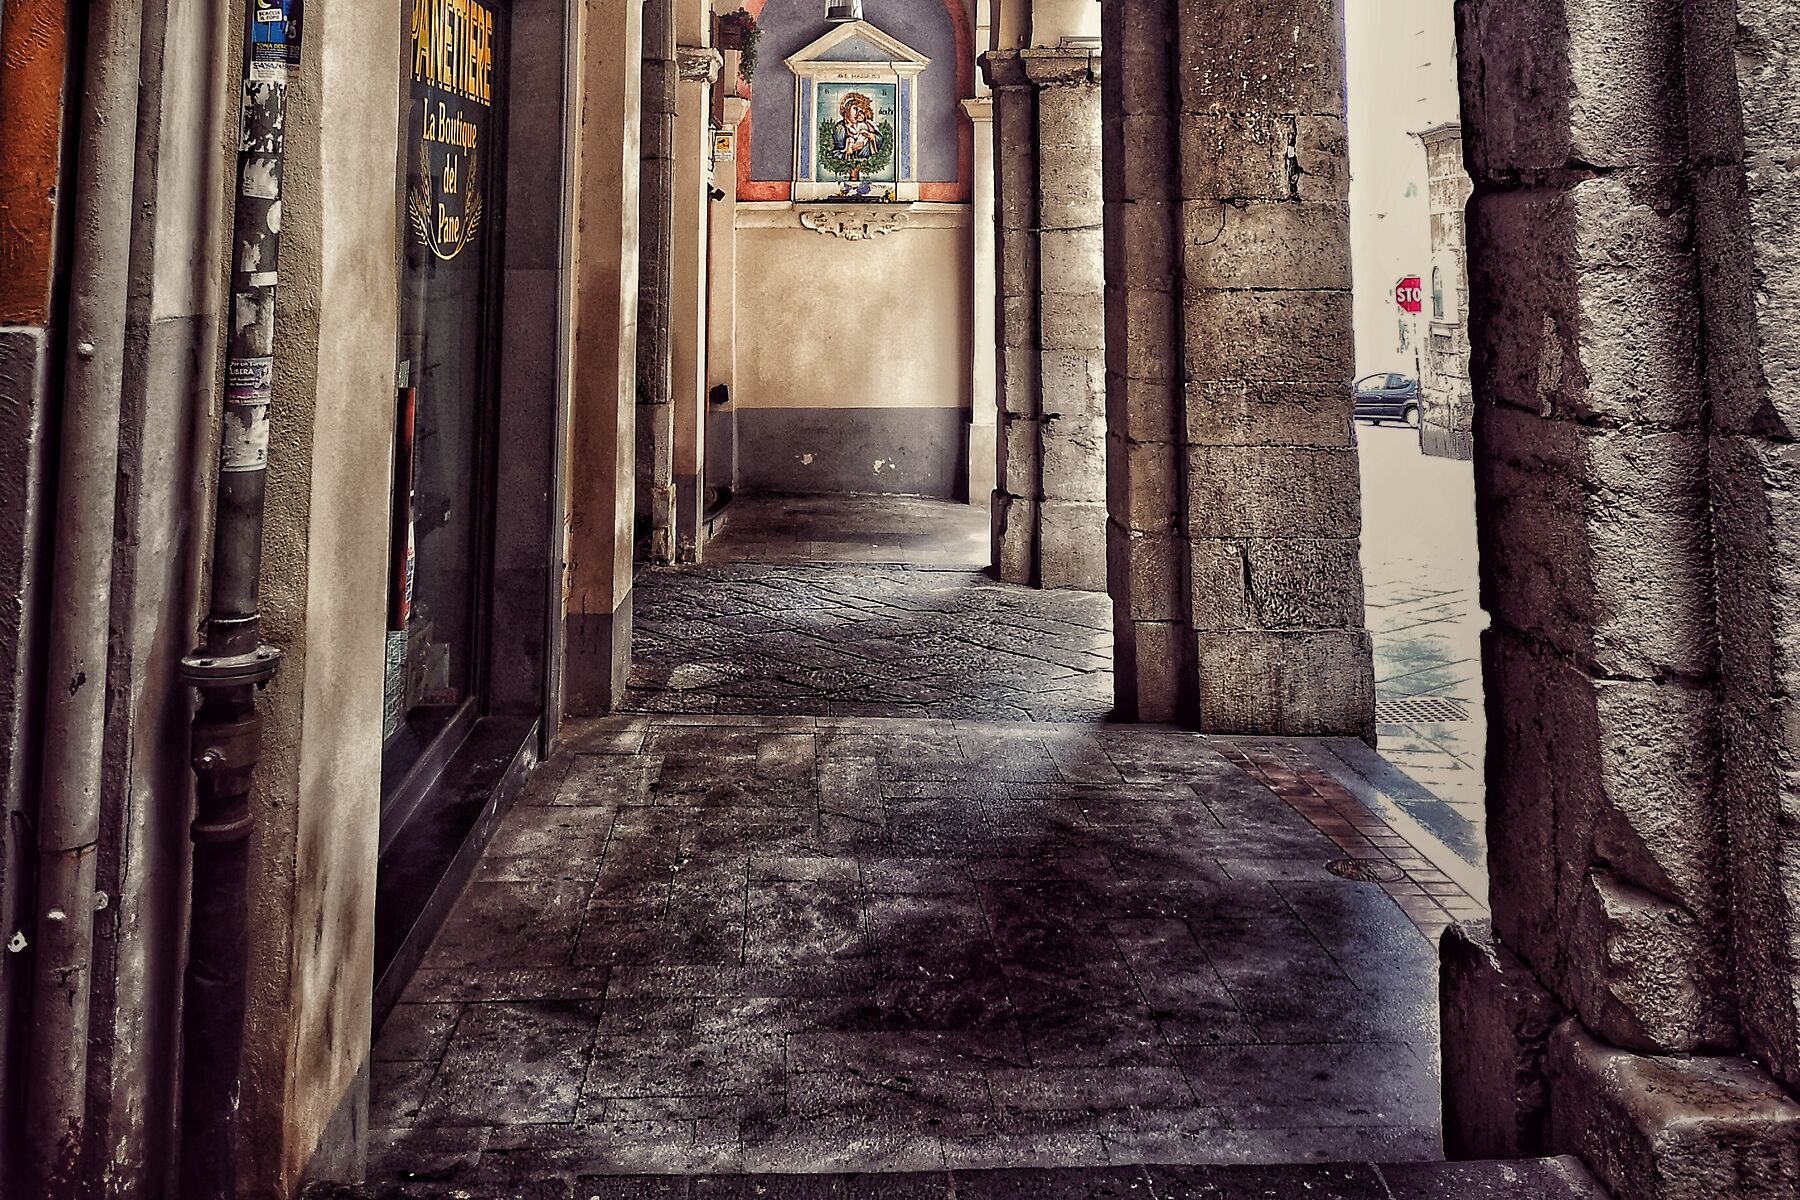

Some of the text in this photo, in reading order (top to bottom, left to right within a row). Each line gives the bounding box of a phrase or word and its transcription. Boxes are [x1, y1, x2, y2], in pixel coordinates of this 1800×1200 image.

[423, 98, 477, 157] La Boutique
[444, 153, 458, 194] del
[438, 202, 460, 244] Pane
[1397, 287, 1421, 303] STO
